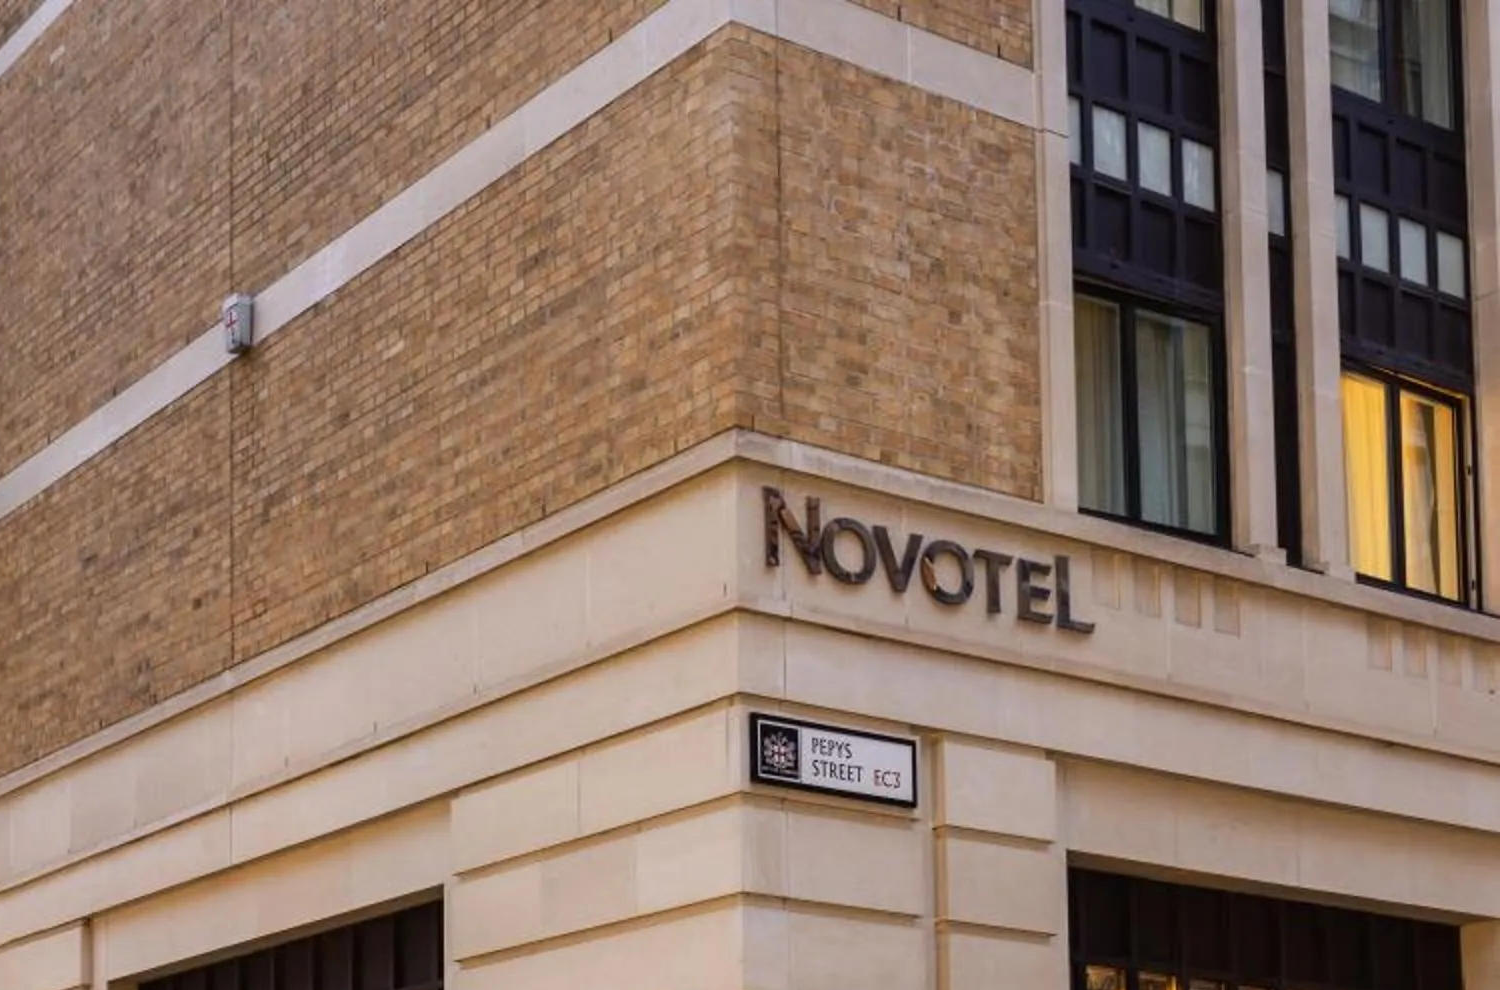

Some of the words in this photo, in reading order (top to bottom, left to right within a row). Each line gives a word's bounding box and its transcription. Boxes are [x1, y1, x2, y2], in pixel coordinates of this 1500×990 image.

[762, 485, 1096, 635] NOVOTEL
[811, 737, 853, 759] PEPYS
[812, 760, 864, 783] STREET
[873, 769, 901, 789] EC3
